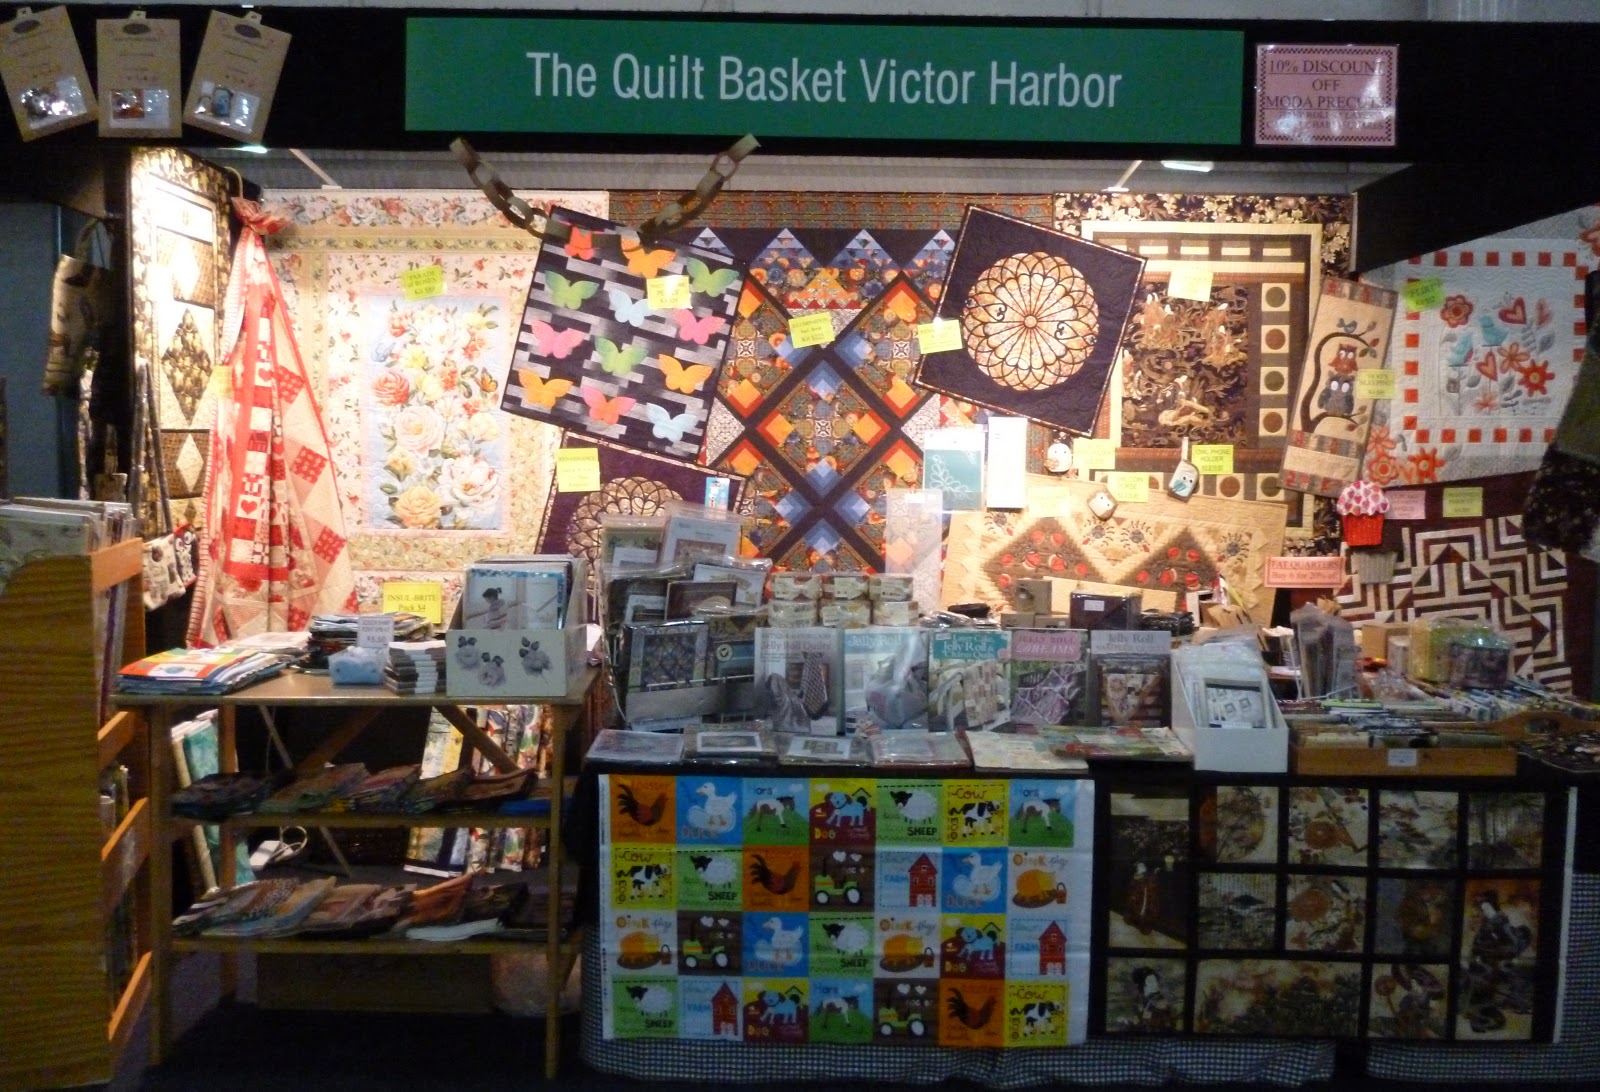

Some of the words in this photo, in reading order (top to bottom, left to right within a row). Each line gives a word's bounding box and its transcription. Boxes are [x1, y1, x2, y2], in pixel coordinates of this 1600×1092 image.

[1269, 60, 1298, 73] 10%
[1303, 60, 1386, 73] DISCOUNT
[526, 52, 597, 98] The
[612, 53, 705, 101] Quilt
[719, 56, 847, 103] Basket
[860, 59, 976, 105] Victor
[989, 61, 1123, 108] Harbor
[1312, 78, 1341, 91] OFF
[1265, 96, 1313, 108] MODA
[1290, 561, 1339, 570] QUARTERS
[848, 635, 878, 649] Jelly
[879, 635, 902, 646] Roll
[1108, 633, 1129, 643] Jelly
[1133, 633, 1154, 643] Roll
[966, 641, 987, 651] Roll
[907, 826, 938, 837] SHEEP
[708, 890, 738, 901] SHEEP
[840, 957, 869, 968] SHEEP
